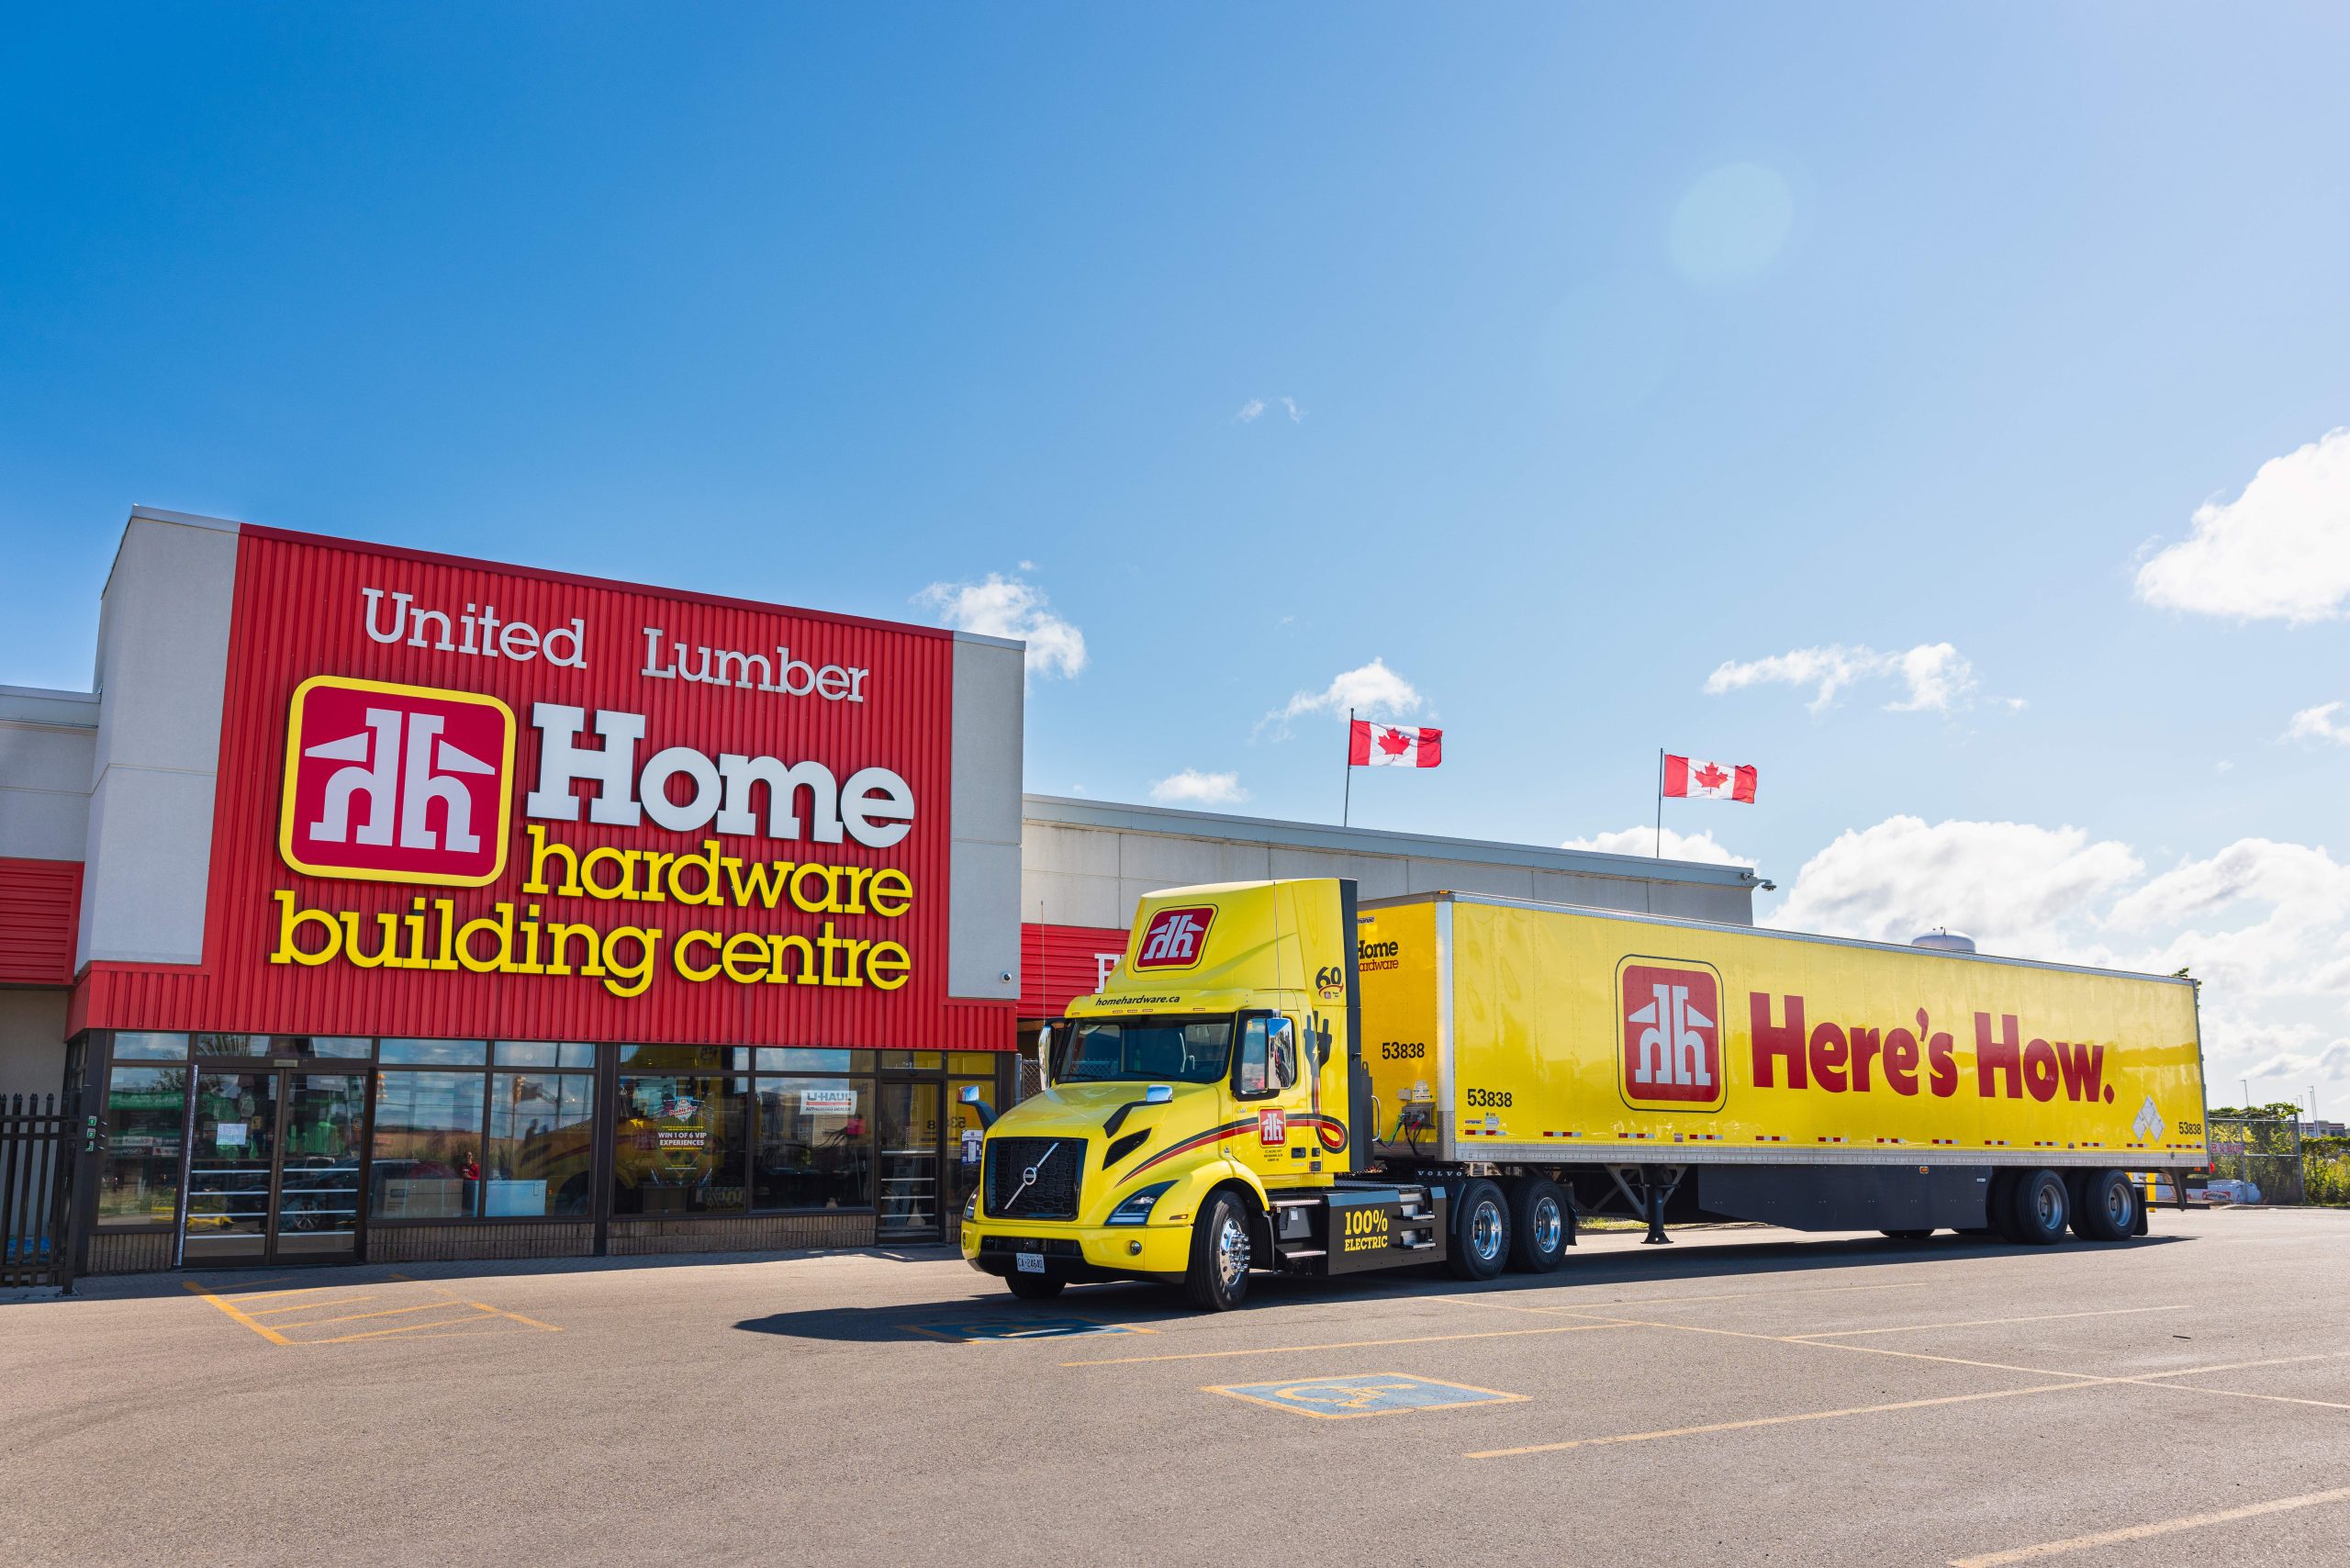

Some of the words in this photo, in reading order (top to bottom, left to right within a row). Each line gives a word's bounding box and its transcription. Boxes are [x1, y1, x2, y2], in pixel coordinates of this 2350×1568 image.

[362, 587, 588, 669] United
[642, 627, 869, 702] Lumber
[526, 702, 915, 848] Home
[522, 824, 914, 917] hardware
[270, 890, 663, 998] building
[674, 922, 912, 991] centre
[1359, 959, 1399, 972] ardware
[1315, 967, 1342, 990] 60
[1095, 995, 1181, 1006] homehardware.ca
[1382, 1041, 1425, 1059] 53838
[1749, 991, 1959, 1098] Here's
[1974, 1011, 2116, 1104] How.
[1467, 1088, 1513, 1107] 53838
[2178, 1122, 2202, 1135] 53838
[1345, 1209, 1388, 1236] 100%
[1344, 1235, 1388, 1252] ELECTRIC
